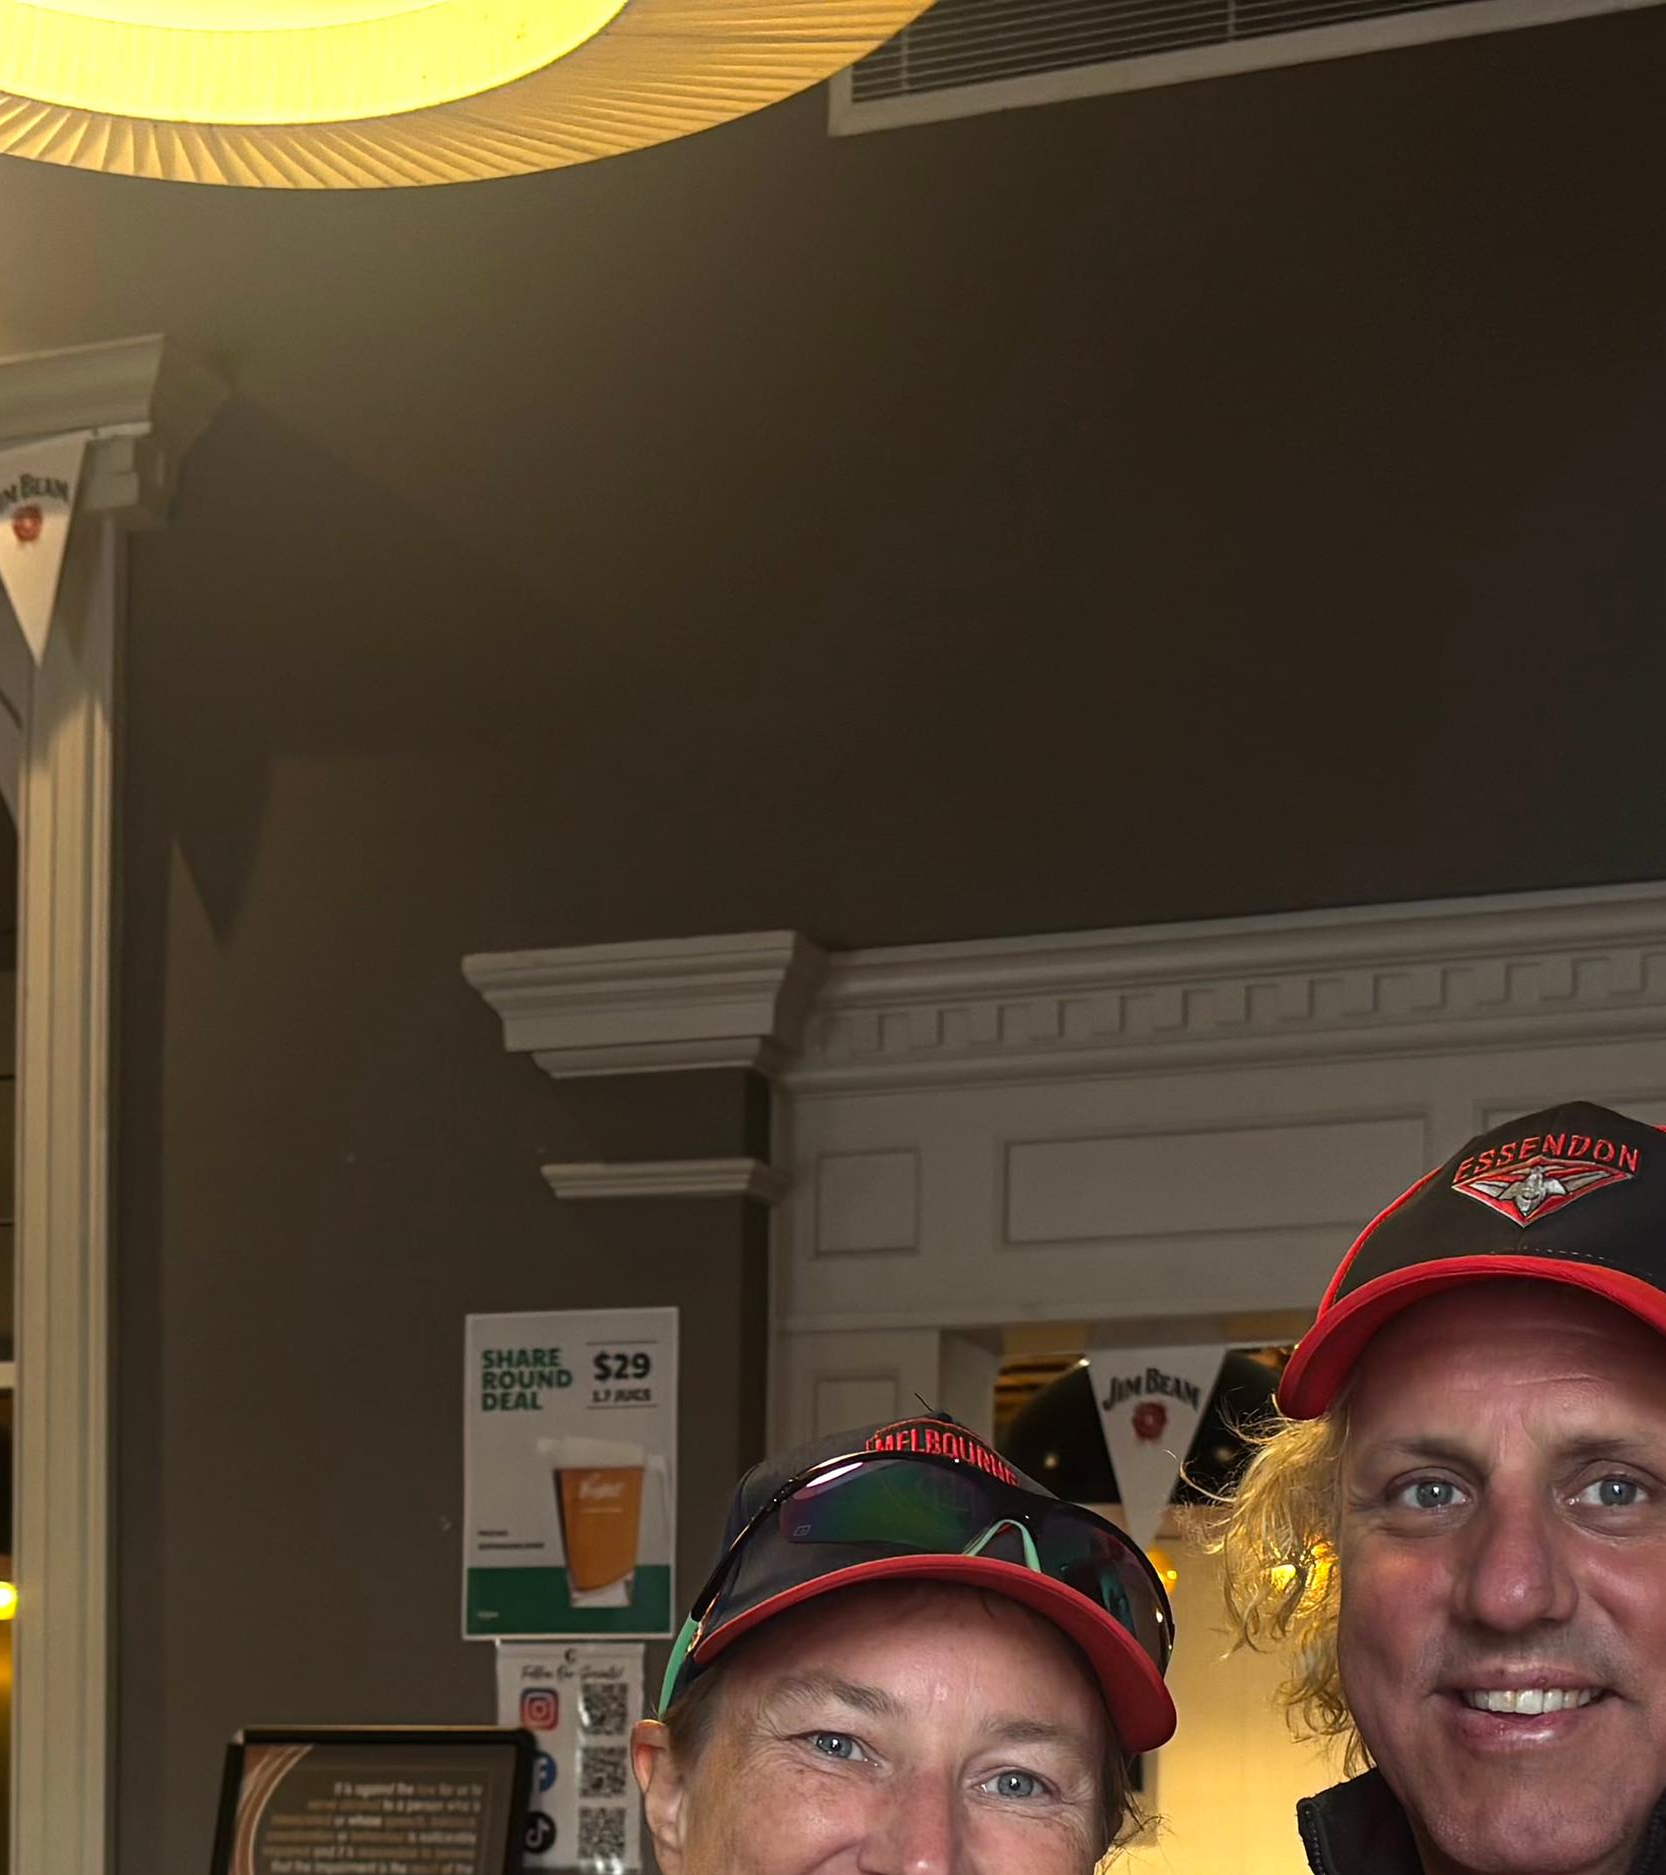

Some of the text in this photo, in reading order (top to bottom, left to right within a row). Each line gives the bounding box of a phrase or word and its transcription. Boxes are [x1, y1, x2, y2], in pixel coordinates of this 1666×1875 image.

[1454, 1132, 1641, 1183] ESSENDON
[482, 1348, 560, 1369] SHARE
[593, 1350, 650, 1383] $29
[482, 1369, 573, 1389] ROUND
[482, 1390, 543, 1411] DEAL
